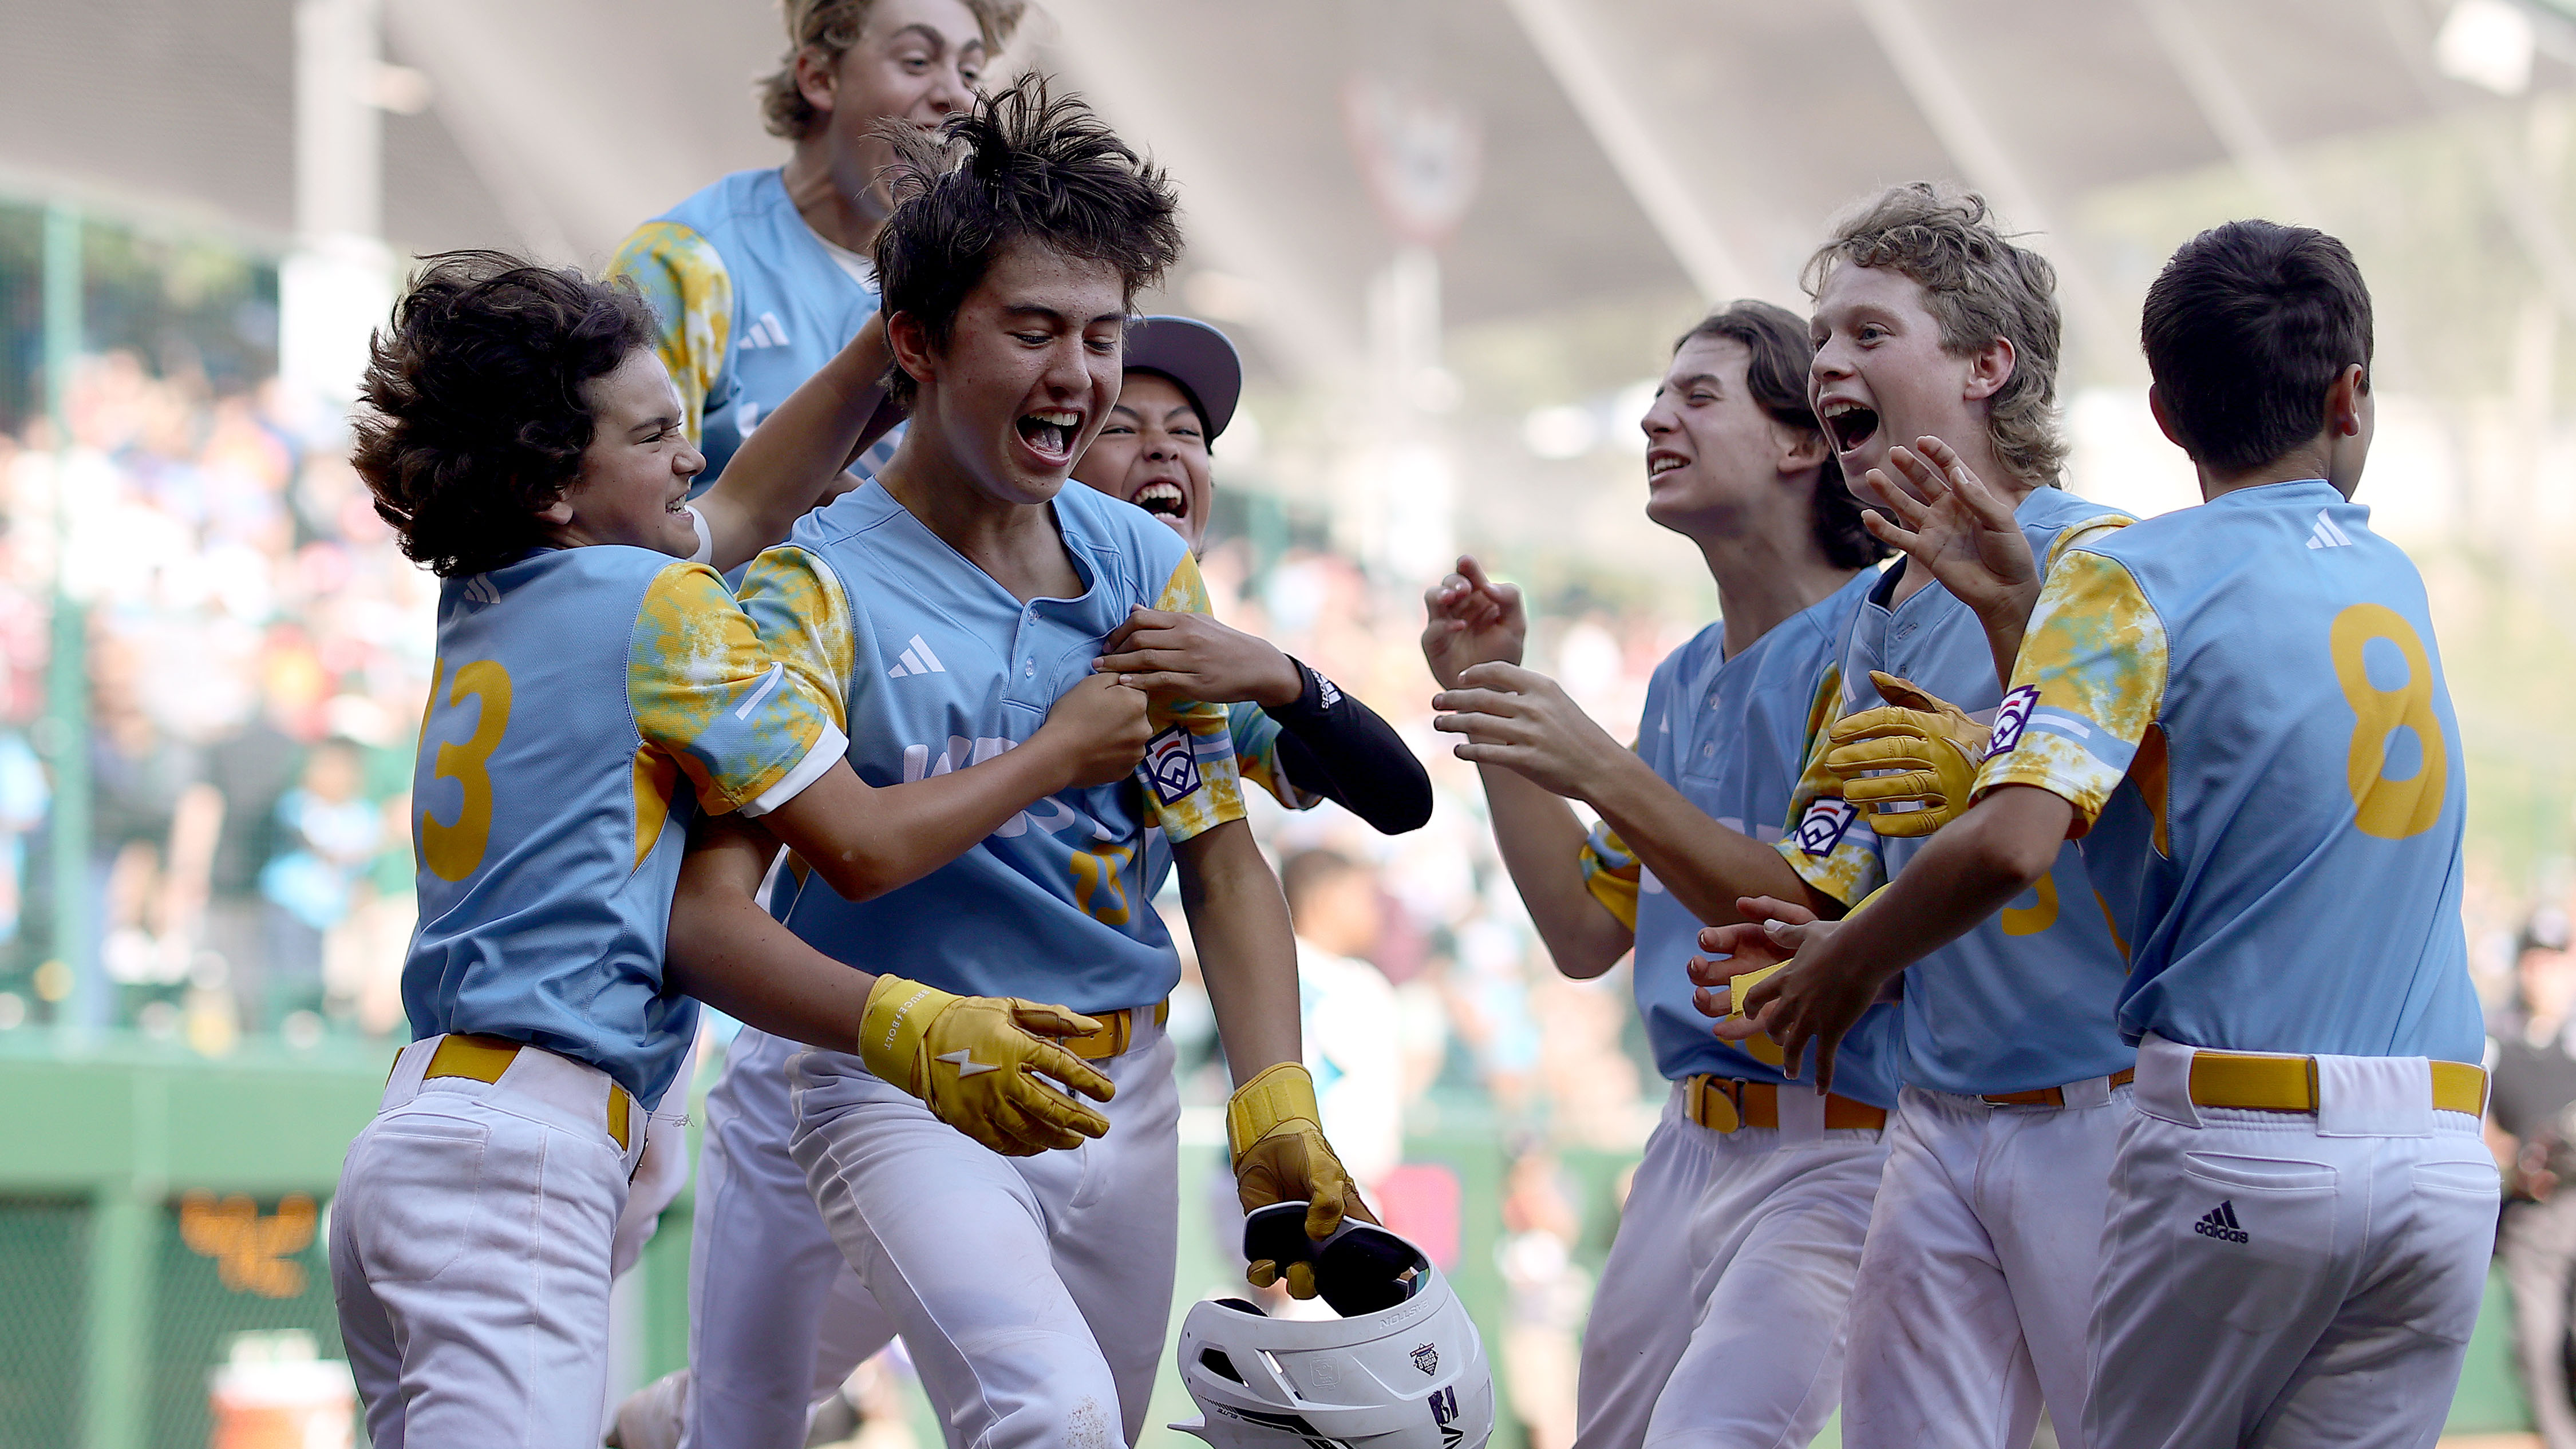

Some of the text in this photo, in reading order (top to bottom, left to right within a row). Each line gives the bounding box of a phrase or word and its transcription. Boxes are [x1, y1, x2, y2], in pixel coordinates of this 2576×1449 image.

[2330, 603, 2447, 840] 8
[412, 658, 512, 882] 3
[884, 989, 930, 1050] BRUCE BOLT
[2195, 1221, 2249, 1244] adidas
[1379, 1298, 1429, 1329] EASTON
[1417, 1351, 1435, 1363] SERIES
[1419, 1357, 1436, 1369] WORLD
